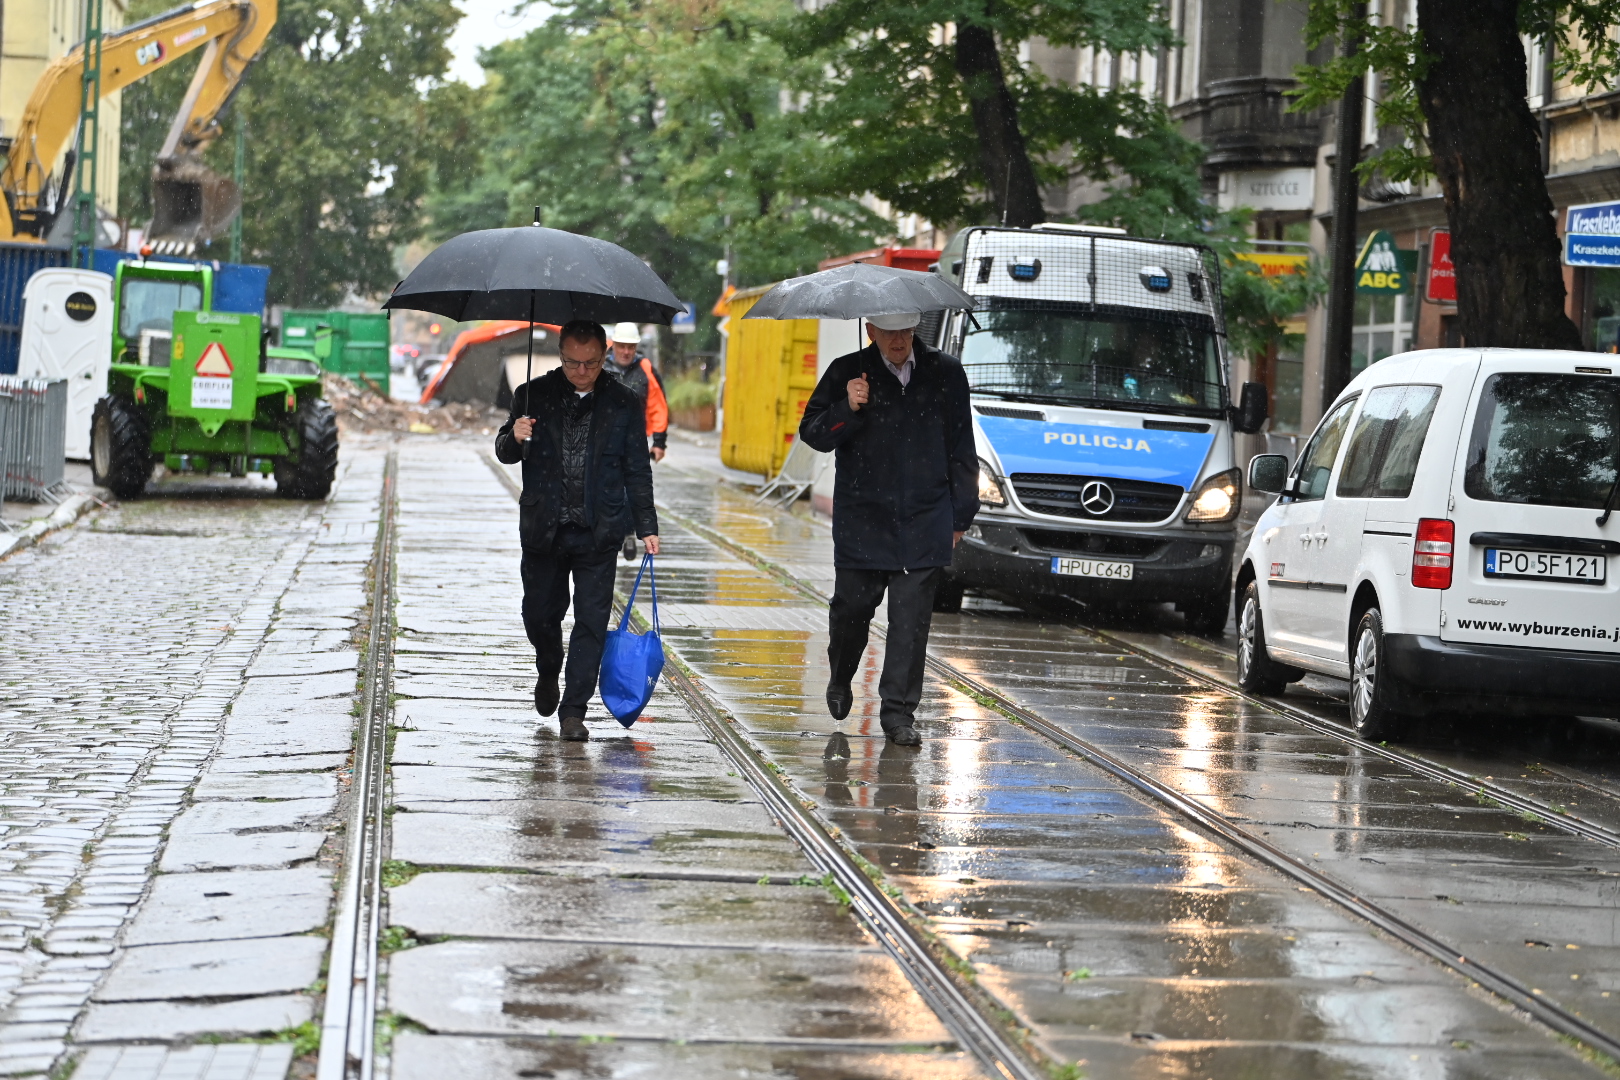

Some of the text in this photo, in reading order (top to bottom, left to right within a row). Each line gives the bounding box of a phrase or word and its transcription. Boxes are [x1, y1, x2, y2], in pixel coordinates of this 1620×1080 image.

[135, 40, 161, 66] CAT
[1358, 272, 1401, 289] ABC
[1044, 432, 1152, 453] POLICJA
[1060, 559, 1092, 575] HPU
[1096, 562, 1131, 578] C643
[1499, 552, 1529, 573] PO
[1537, 554, 1598, 578] 5F121
[1467, 596, 1508, 607] CADDY
[1457, 618, 1620, 643] www.wyburzenia.j
